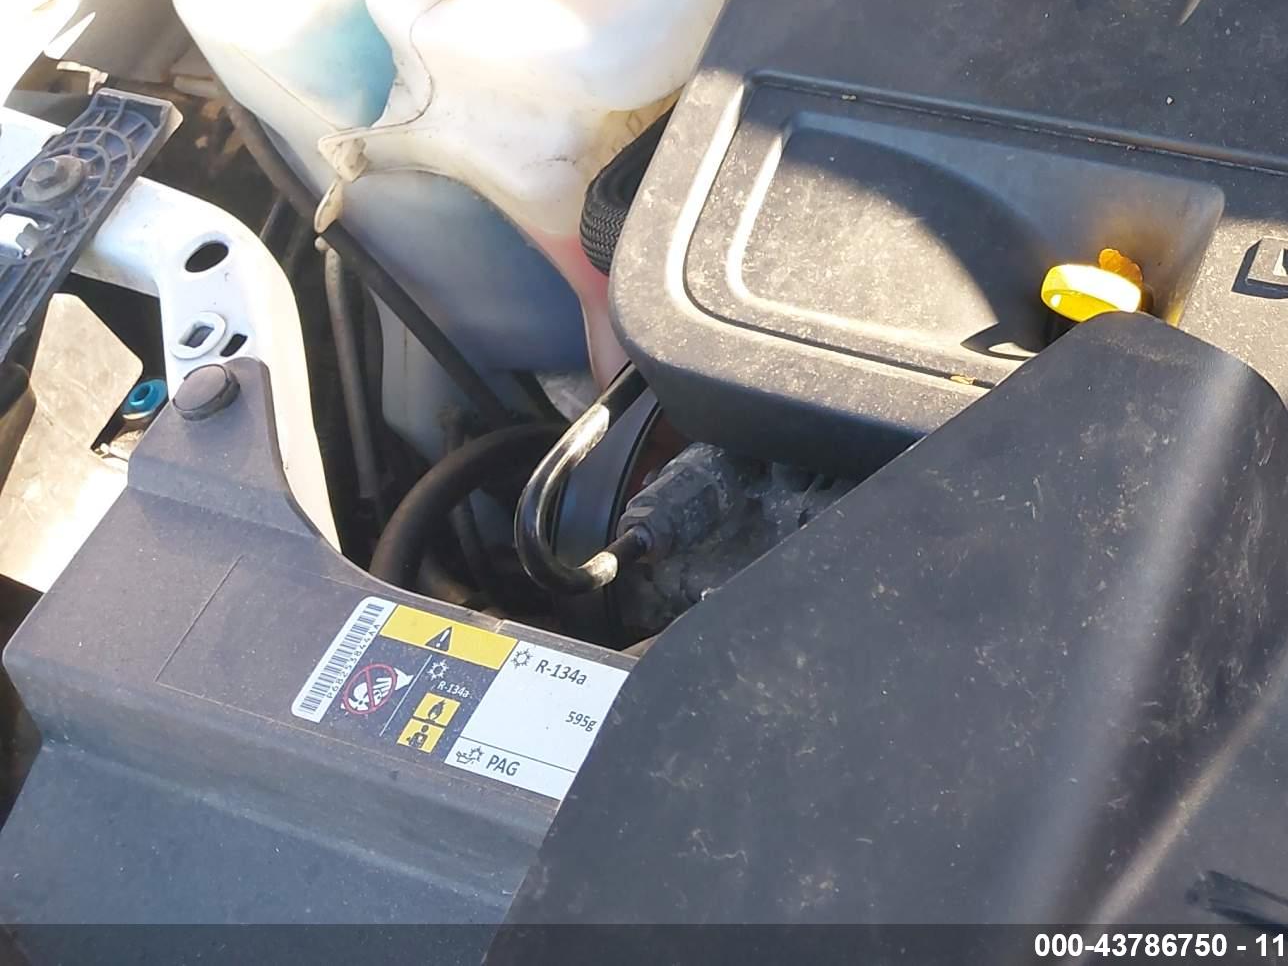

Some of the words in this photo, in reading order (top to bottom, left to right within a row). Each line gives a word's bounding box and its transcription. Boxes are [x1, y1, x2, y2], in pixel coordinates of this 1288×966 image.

[535, 659, 587, 685] R-134a
[437, 680, 470, 699] R-134a
[565, 710, 598, 732] 595g
[485, 754, 520, 776] PAG
